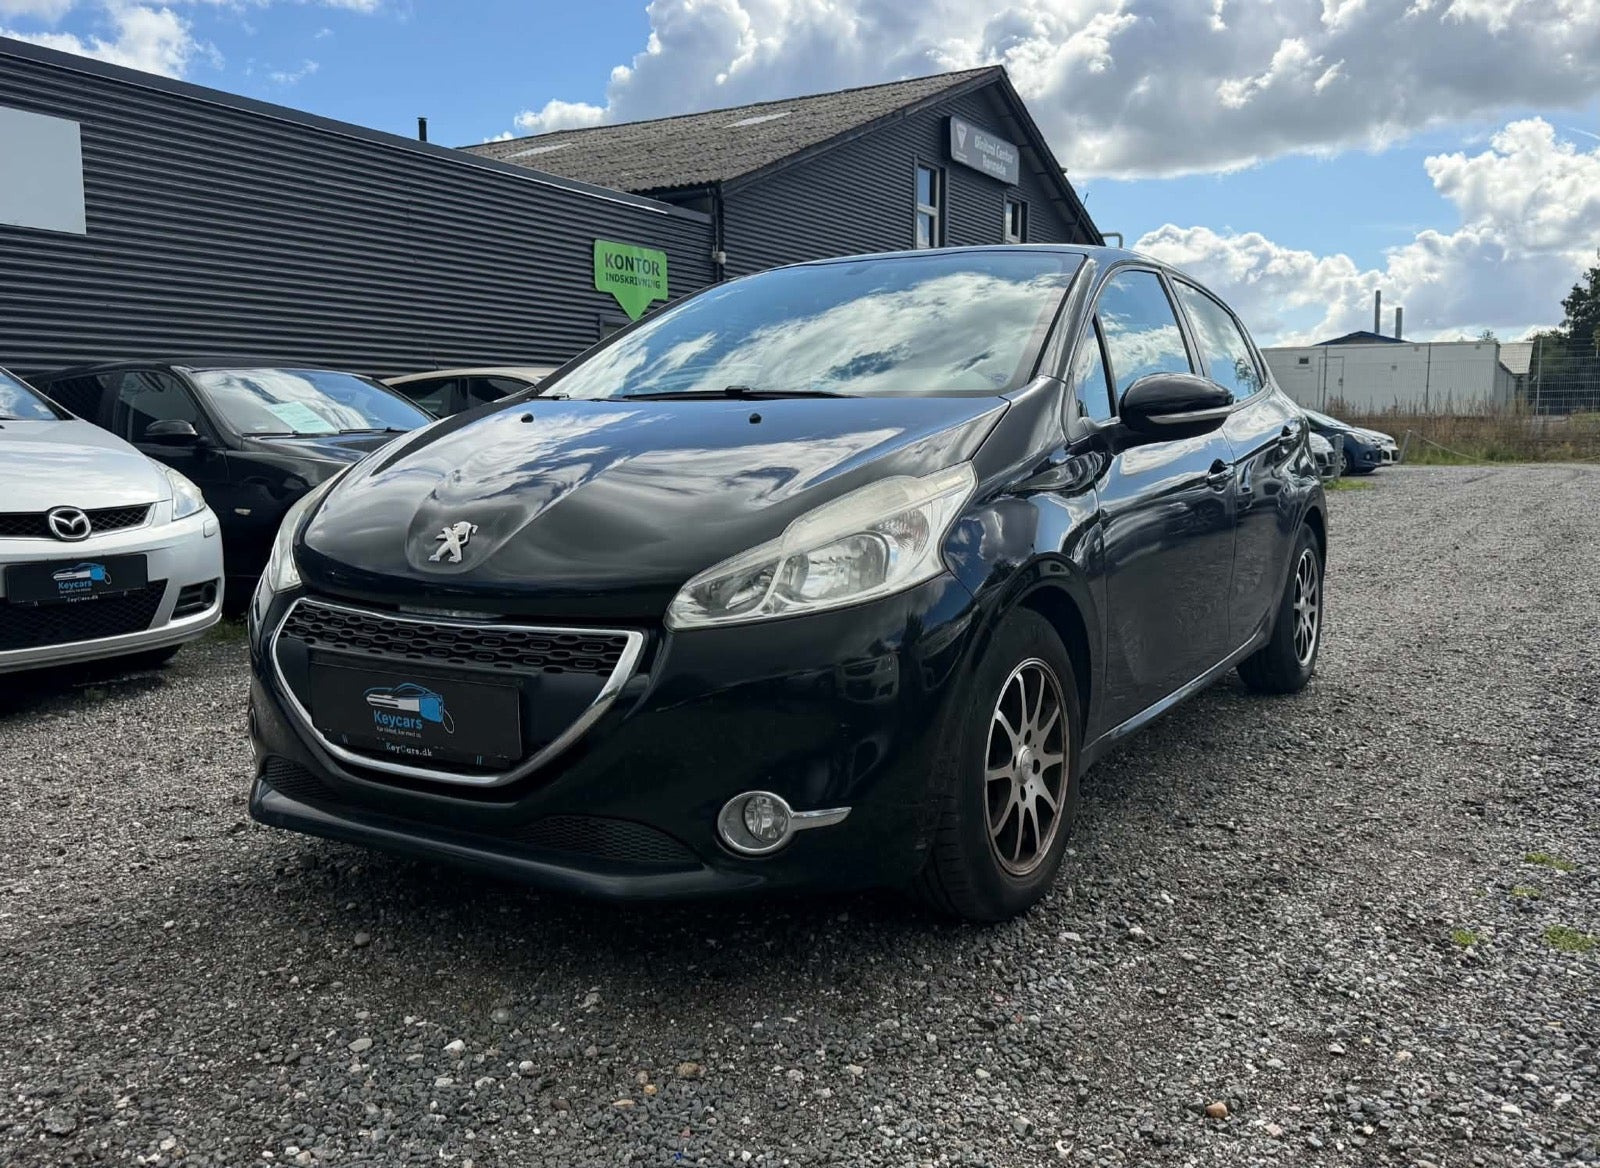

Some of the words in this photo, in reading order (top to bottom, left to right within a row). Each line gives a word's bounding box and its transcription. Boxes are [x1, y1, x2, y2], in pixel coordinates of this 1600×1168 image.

[996, 144, 1014, 165] Center
[604, 252, 661, 277] KONTOR
[605, 272, 661, 290] INDSKRIVNING
[58, 580, 93, 590] Keycars
[373, 709, 423, 730] Keycars
[385, 742, 433, 757] KeyCars.dk
